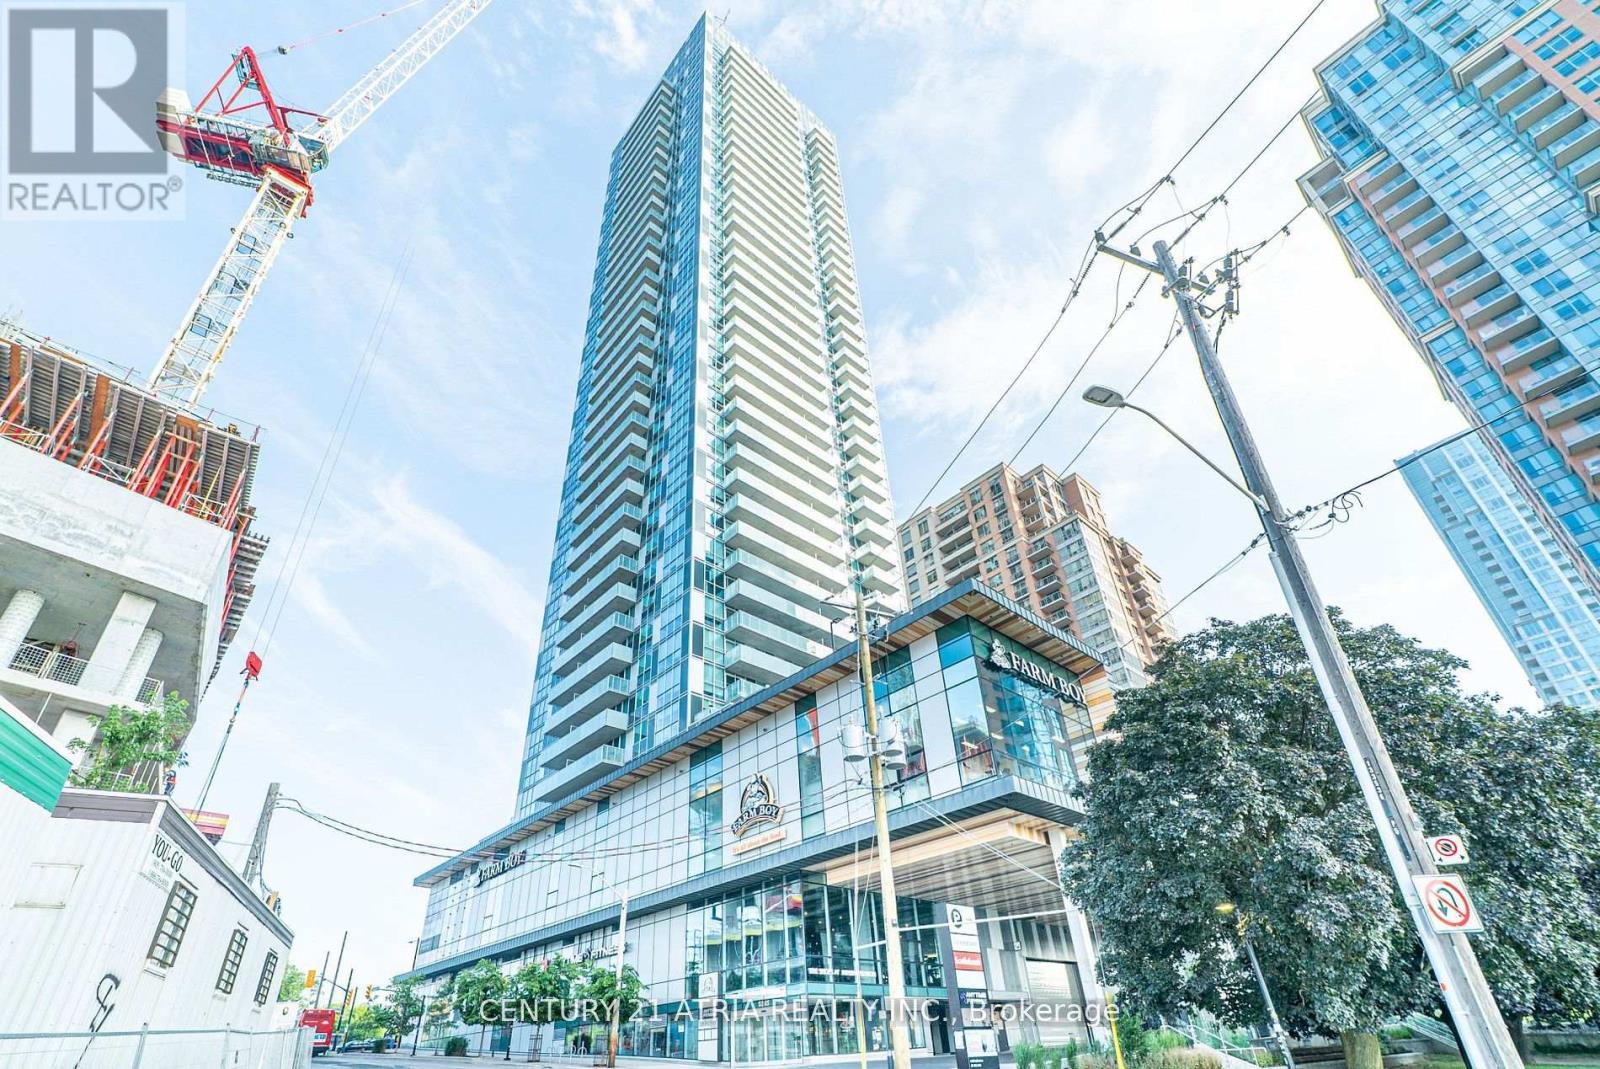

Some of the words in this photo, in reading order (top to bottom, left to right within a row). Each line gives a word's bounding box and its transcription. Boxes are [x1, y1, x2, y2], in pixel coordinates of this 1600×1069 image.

[1010, 651, 1057, 690] FARM
[1058, 676, 1088, 706] BOY
[732, 806, 758, 833] FARM
[759, 805, 779, 818] BOY
